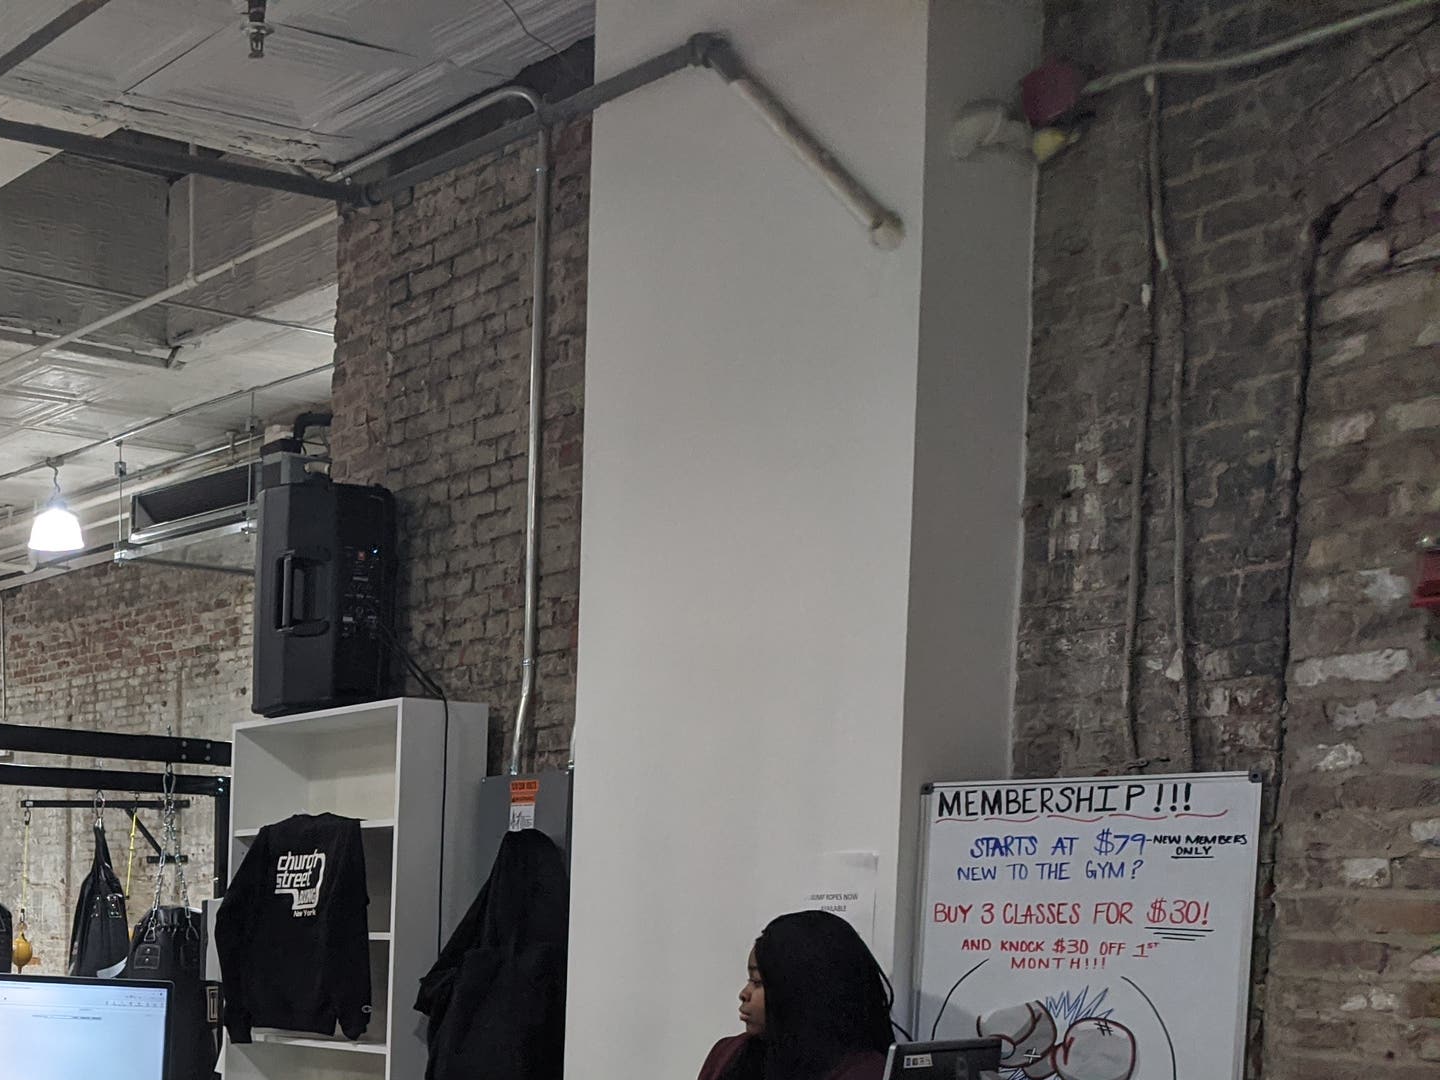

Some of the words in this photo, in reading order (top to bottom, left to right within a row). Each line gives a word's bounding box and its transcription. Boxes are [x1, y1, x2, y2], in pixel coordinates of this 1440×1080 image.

[970, 835, 1038, 858] STARTS
[1051, 837, 1079, 856] AT
[1176, 846, 1212, 856] ONLY
[277, 849, 318, 870] church
[276, 871, 312, 887] street
[958, 866, 997, 881] NEW
[1010, 863, 1028, 879] TO
[1036, 862, 1070, 880] THE
[934, 903, 972, 923] BUY
[981, 903, 995, 924] 3
[1003, 903, 1081, 924] CLASSES
[1094, 902, 1133, 924] FOR
[1147, 898, 1209, 925] $30!
[962, 939, 991, 951] AND
[1000, 940, 1044, 952] KNOCK
[1053, 938, 1089, 955] $30
[1100, 942, 1126, 955] OFF
